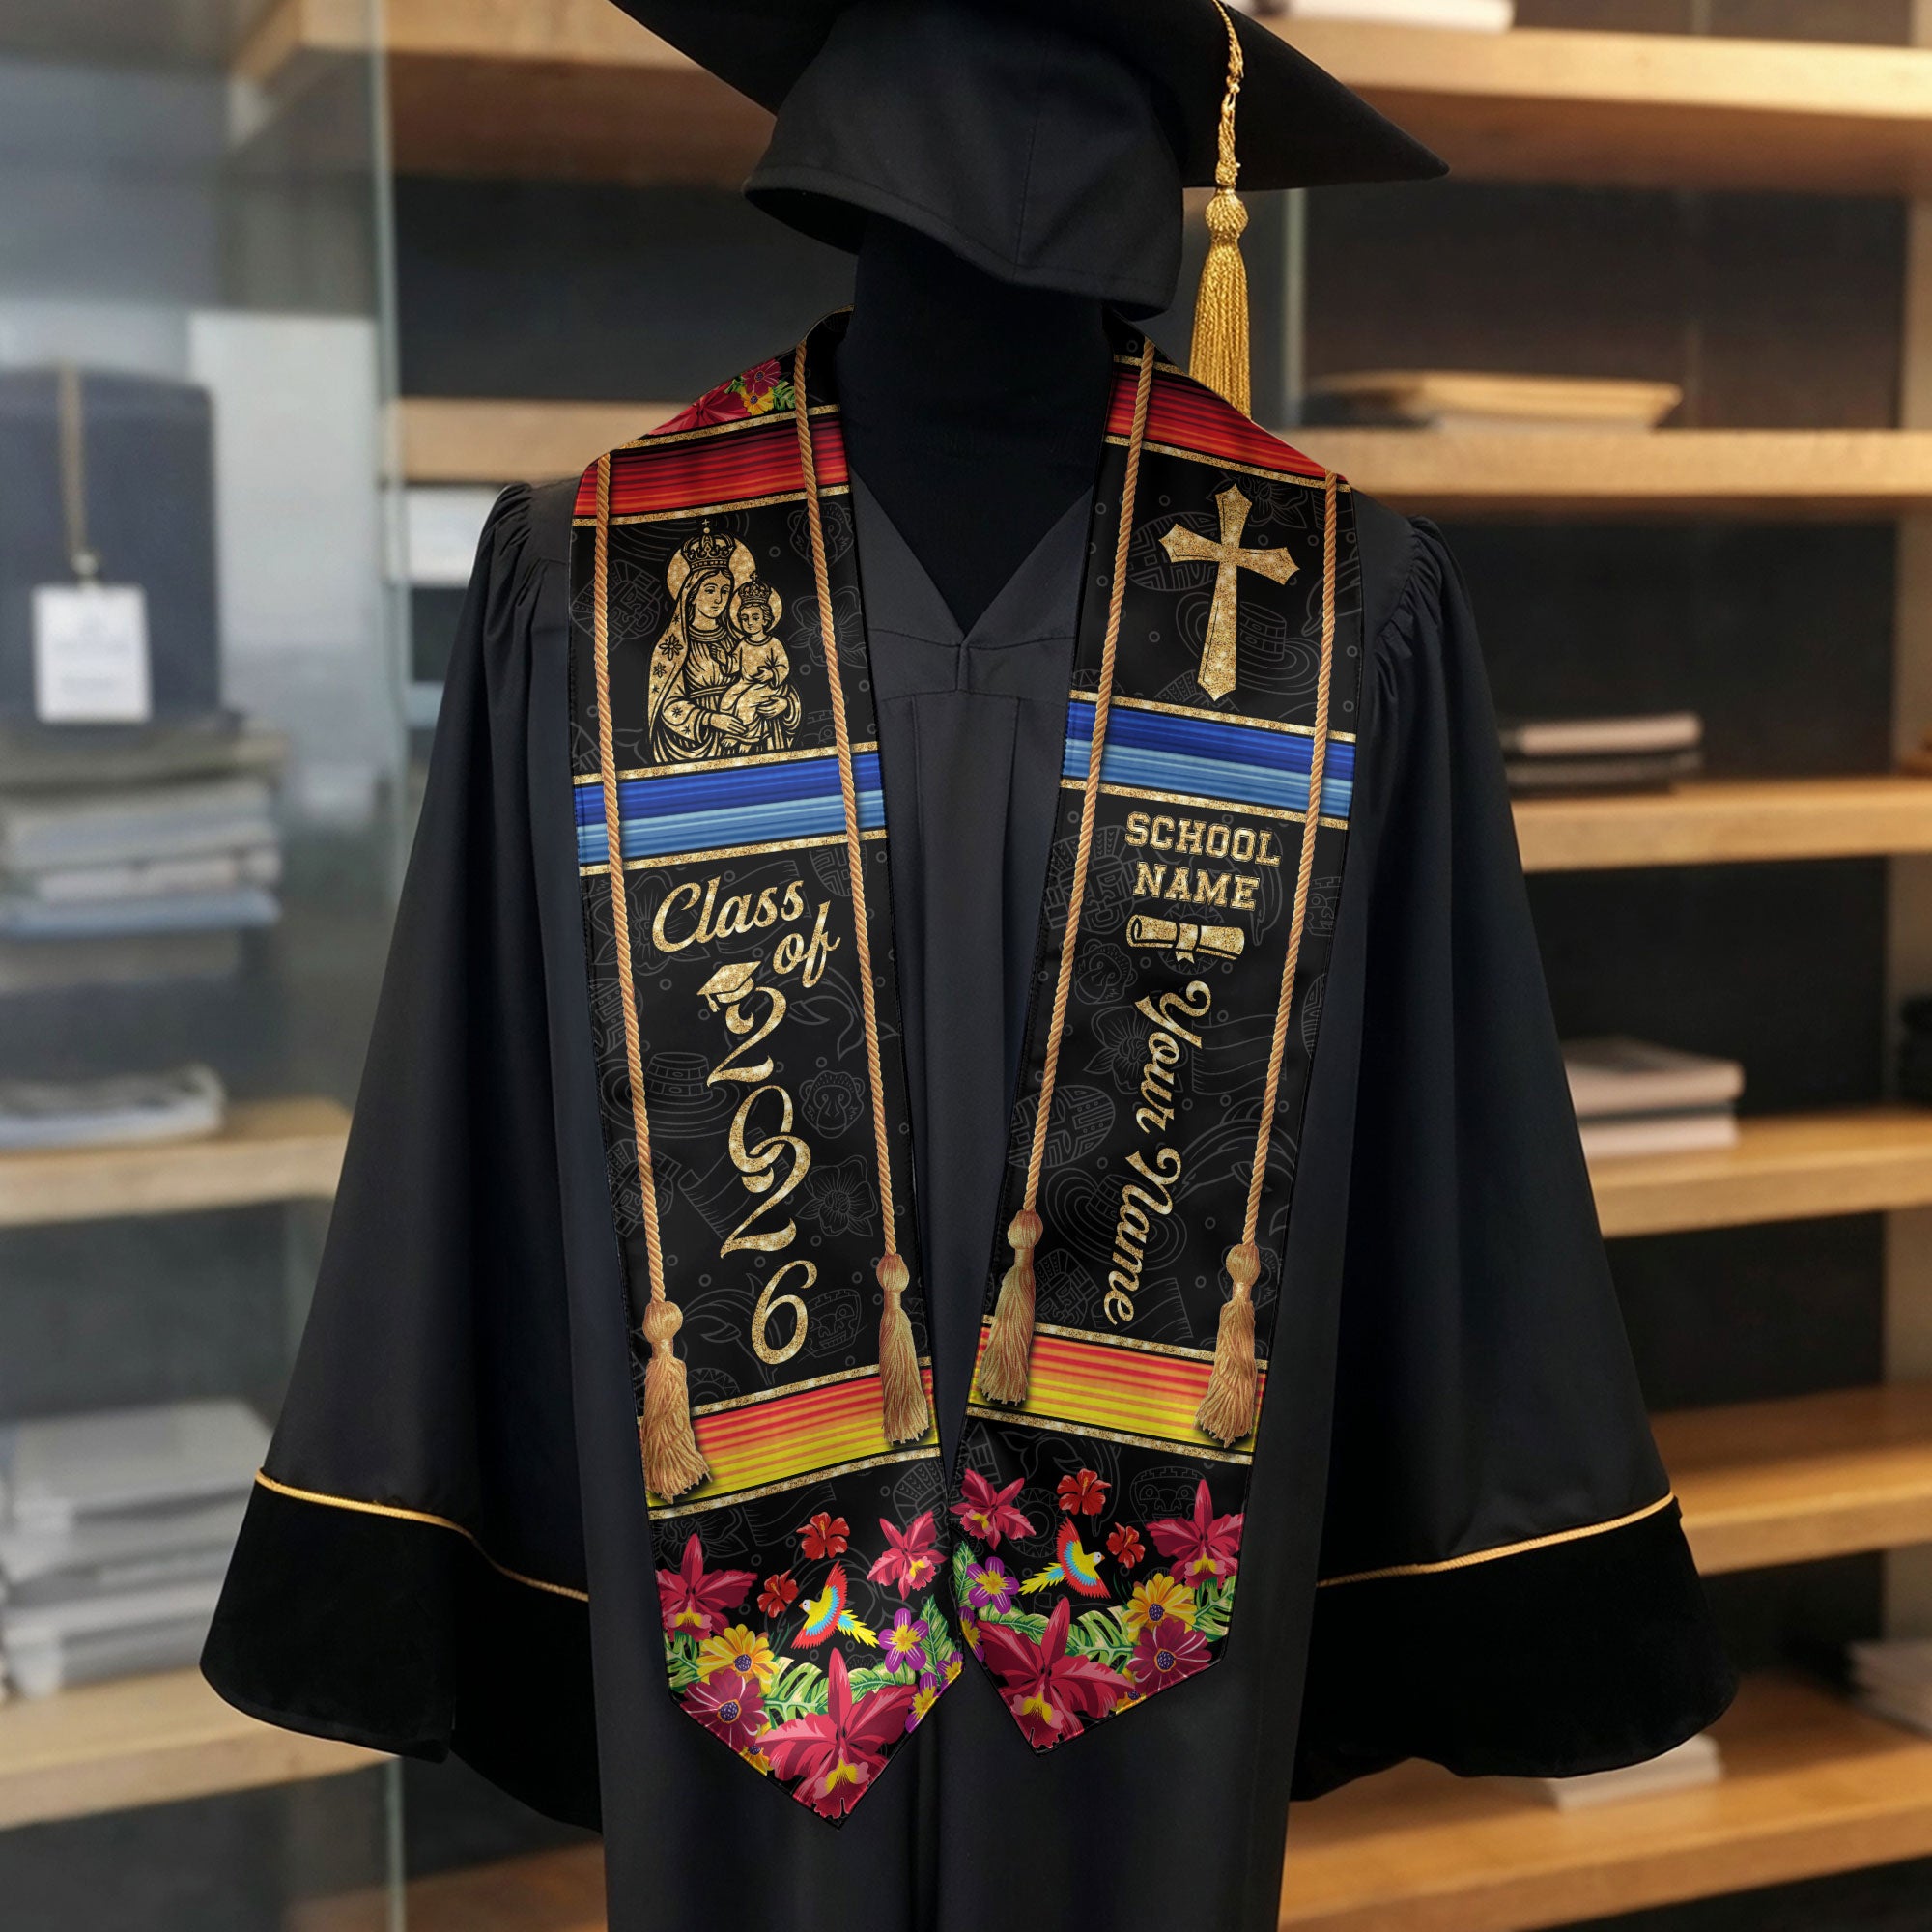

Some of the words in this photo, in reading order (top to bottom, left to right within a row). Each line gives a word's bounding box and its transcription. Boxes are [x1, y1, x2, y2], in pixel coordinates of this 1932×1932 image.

[1124, 811, 1281, 867] SCHOOL
[651, 877, 805, 953] Class
[1132, 861, 1260, 911] NAME
[773, 901, 840, 988] of
[1134, 980, 1211, 1135] Your
[706, 986, 818, 1365] 2026
[1103, 1147, 1181, 1325] Name
